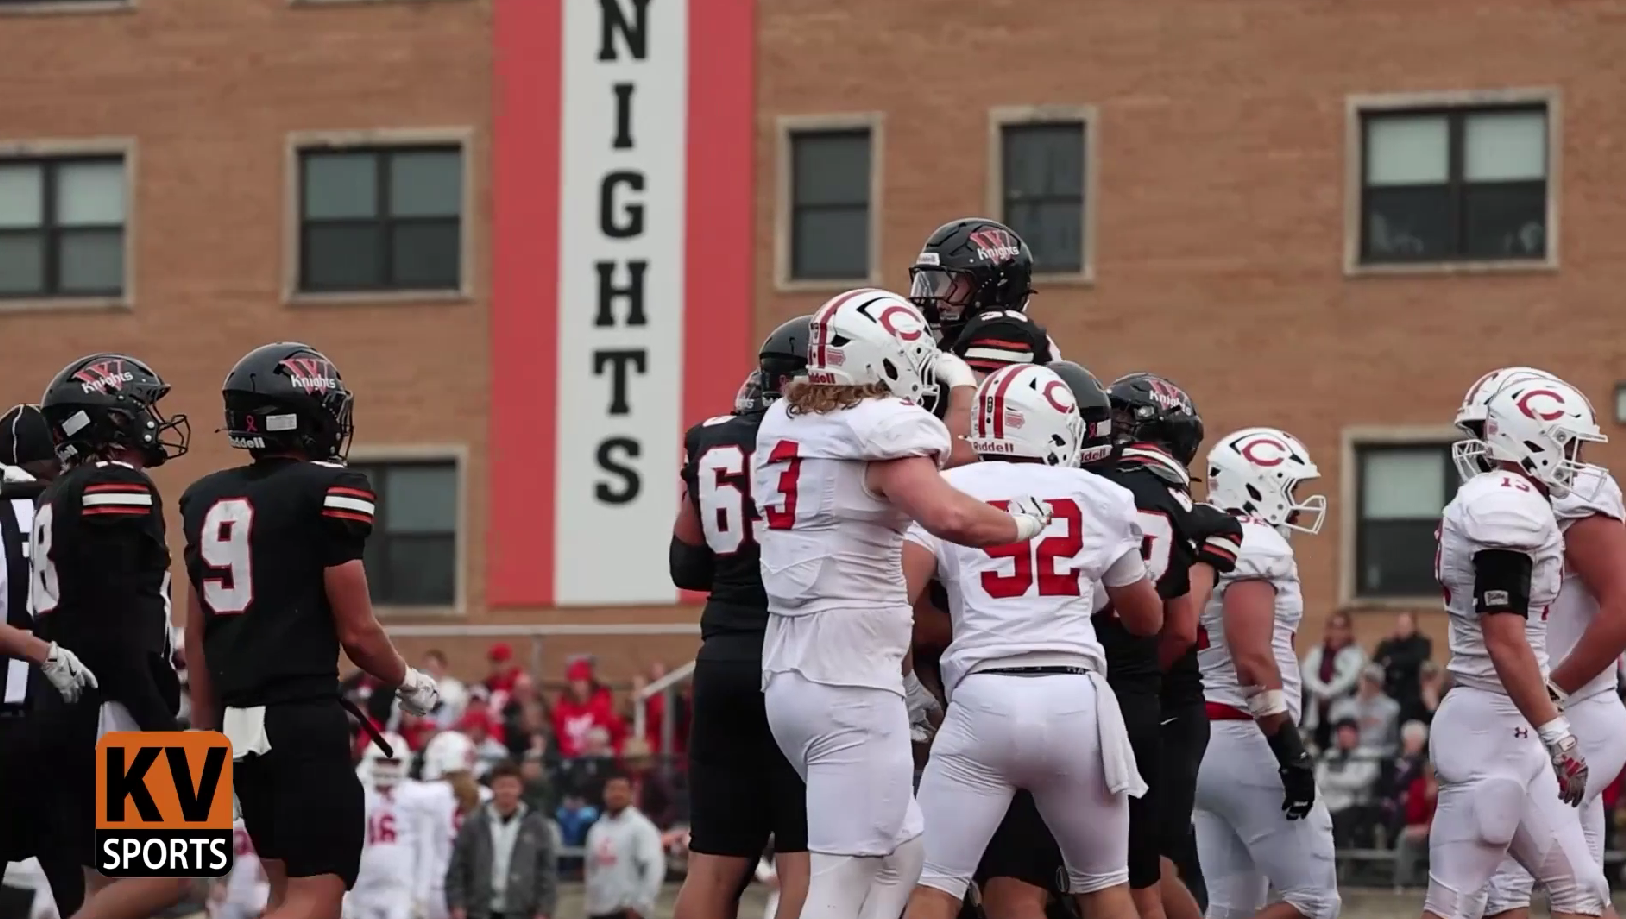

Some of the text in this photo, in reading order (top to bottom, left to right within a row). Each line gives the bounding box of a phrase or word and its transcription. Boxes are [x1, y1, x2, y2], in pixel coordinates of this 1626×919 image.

[82, 371, 134, 394] Knights
[290, 374, 336, 389] Knights
[973, 442, 1014, 453] Riddell
[202, 496, 253, 616] 9
